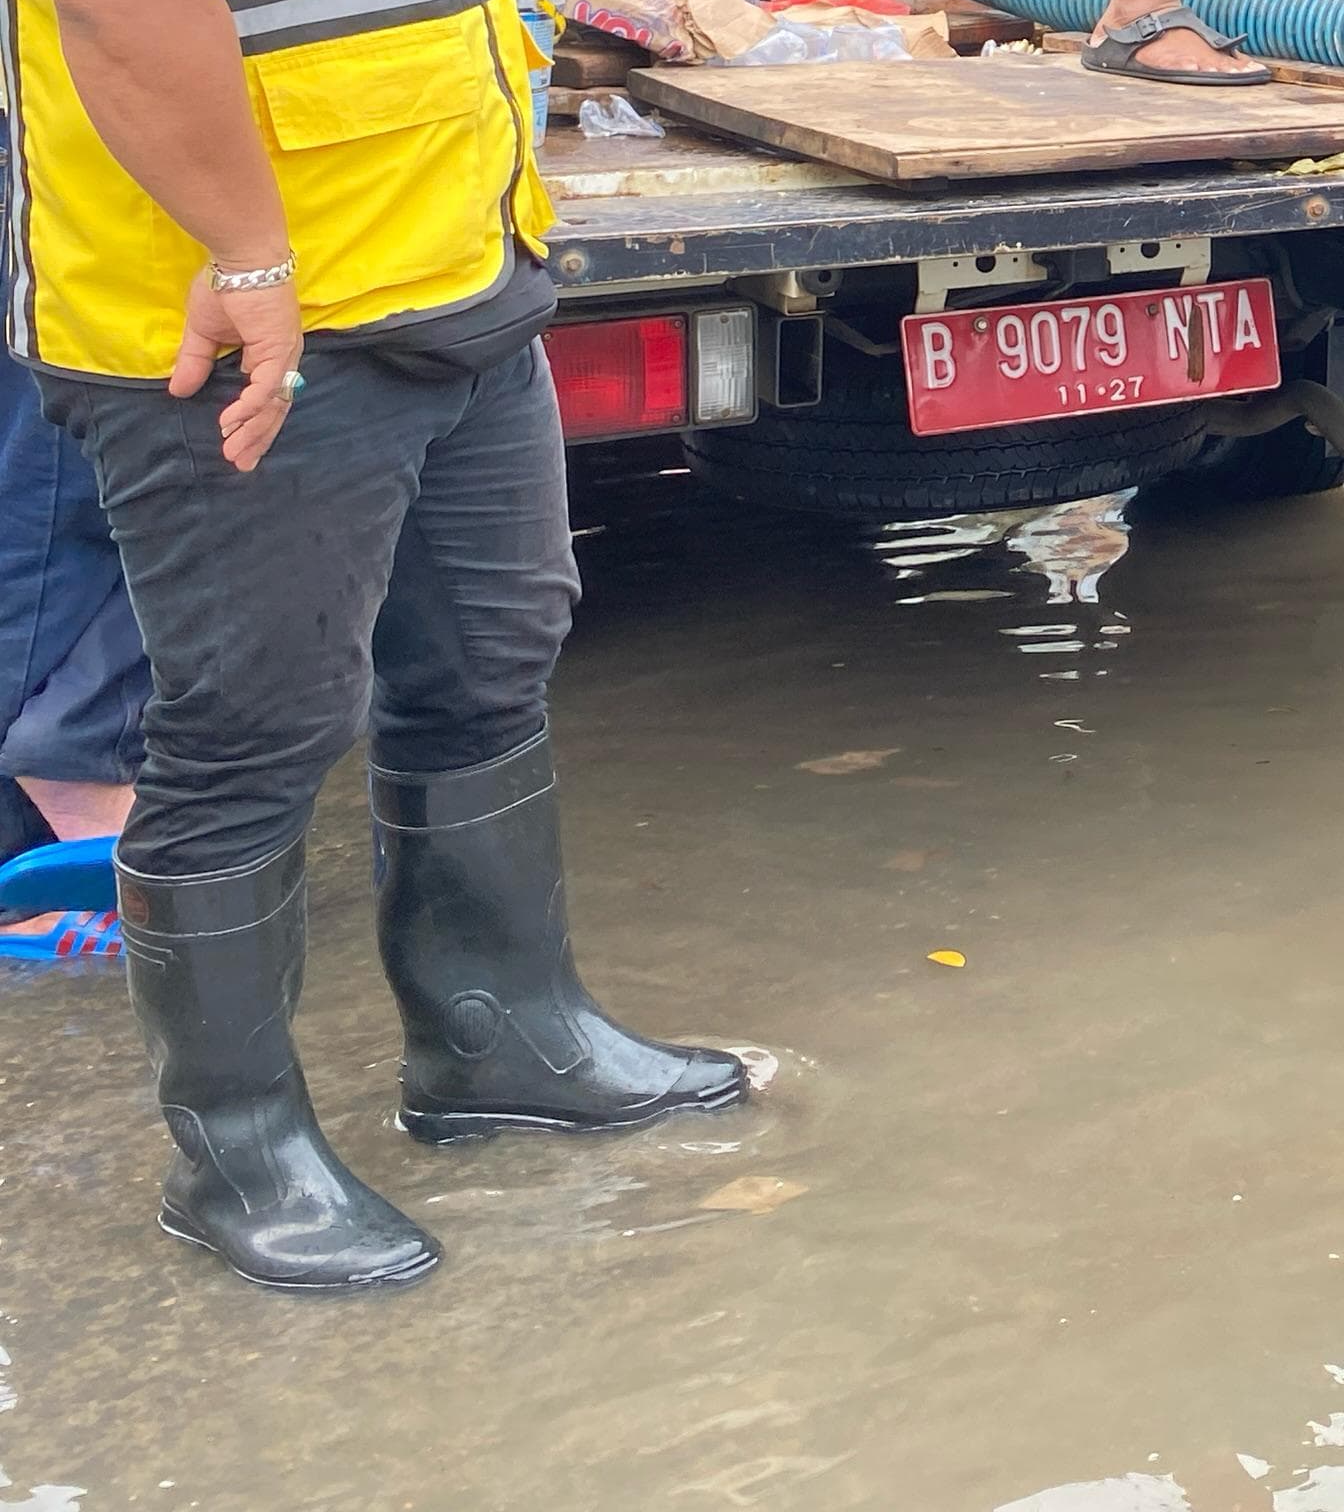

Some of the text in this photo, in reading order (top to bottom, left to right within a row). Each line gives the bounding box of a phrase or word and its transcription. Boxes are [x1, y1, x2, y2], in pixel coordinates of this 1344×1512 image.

[921, 288, 1262, 389] B 9079 NTA
